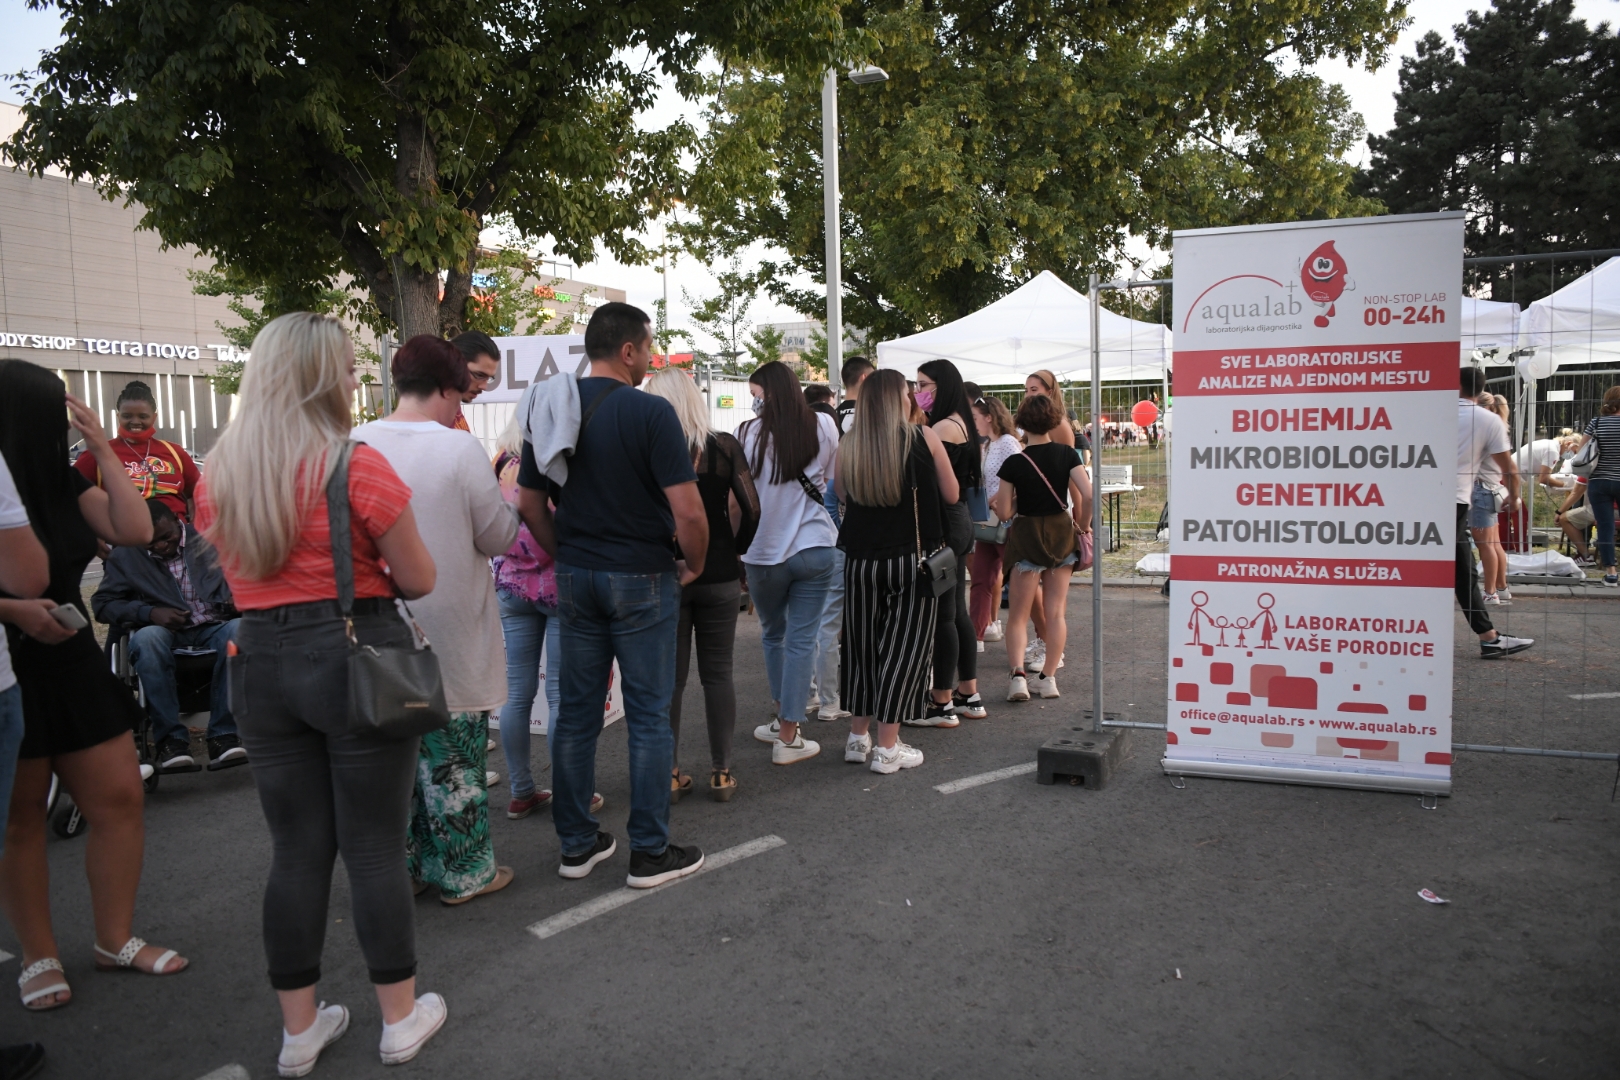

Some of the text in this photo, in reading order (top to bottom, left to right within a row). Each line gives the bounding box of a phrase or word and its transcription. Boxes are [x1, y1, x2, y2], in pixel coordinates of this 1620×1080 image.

[1364, 292, 1447, 304] NON-STOP LAB
[1202, 294, 1302, 325] aqualab
[1364, 306, 1445, 326] 00-24h
[1257, 323, 1302, 332] dijagnostika
[32, 336, 76, 350] SHOP
[1221, 350, 1402, 369] SVE LABORATORIJSKE
[1198, 370, 1430, 389] ANALIZE NA JEDNOM MESTU
[1232, 407, 1393, 432] BIOHEMIJA
[1190, 445, 1437, 469] MIKROBIOLOGIJA
[1236, 483, 1385, 507] GENETIKA
[1182, 519, 1443, 545] PATOHISTOLOGIJA
[1217, 561, 1402, 581] PATRONAŽNA SLUŽBA
[1285, 615, 1430, 634] LABORATORIJA
[1284, 634, 1435, 657] VAŠE PORODICE
[1180, 709, 1437, 736] office@aqualab.rs www.aqualab.rs
